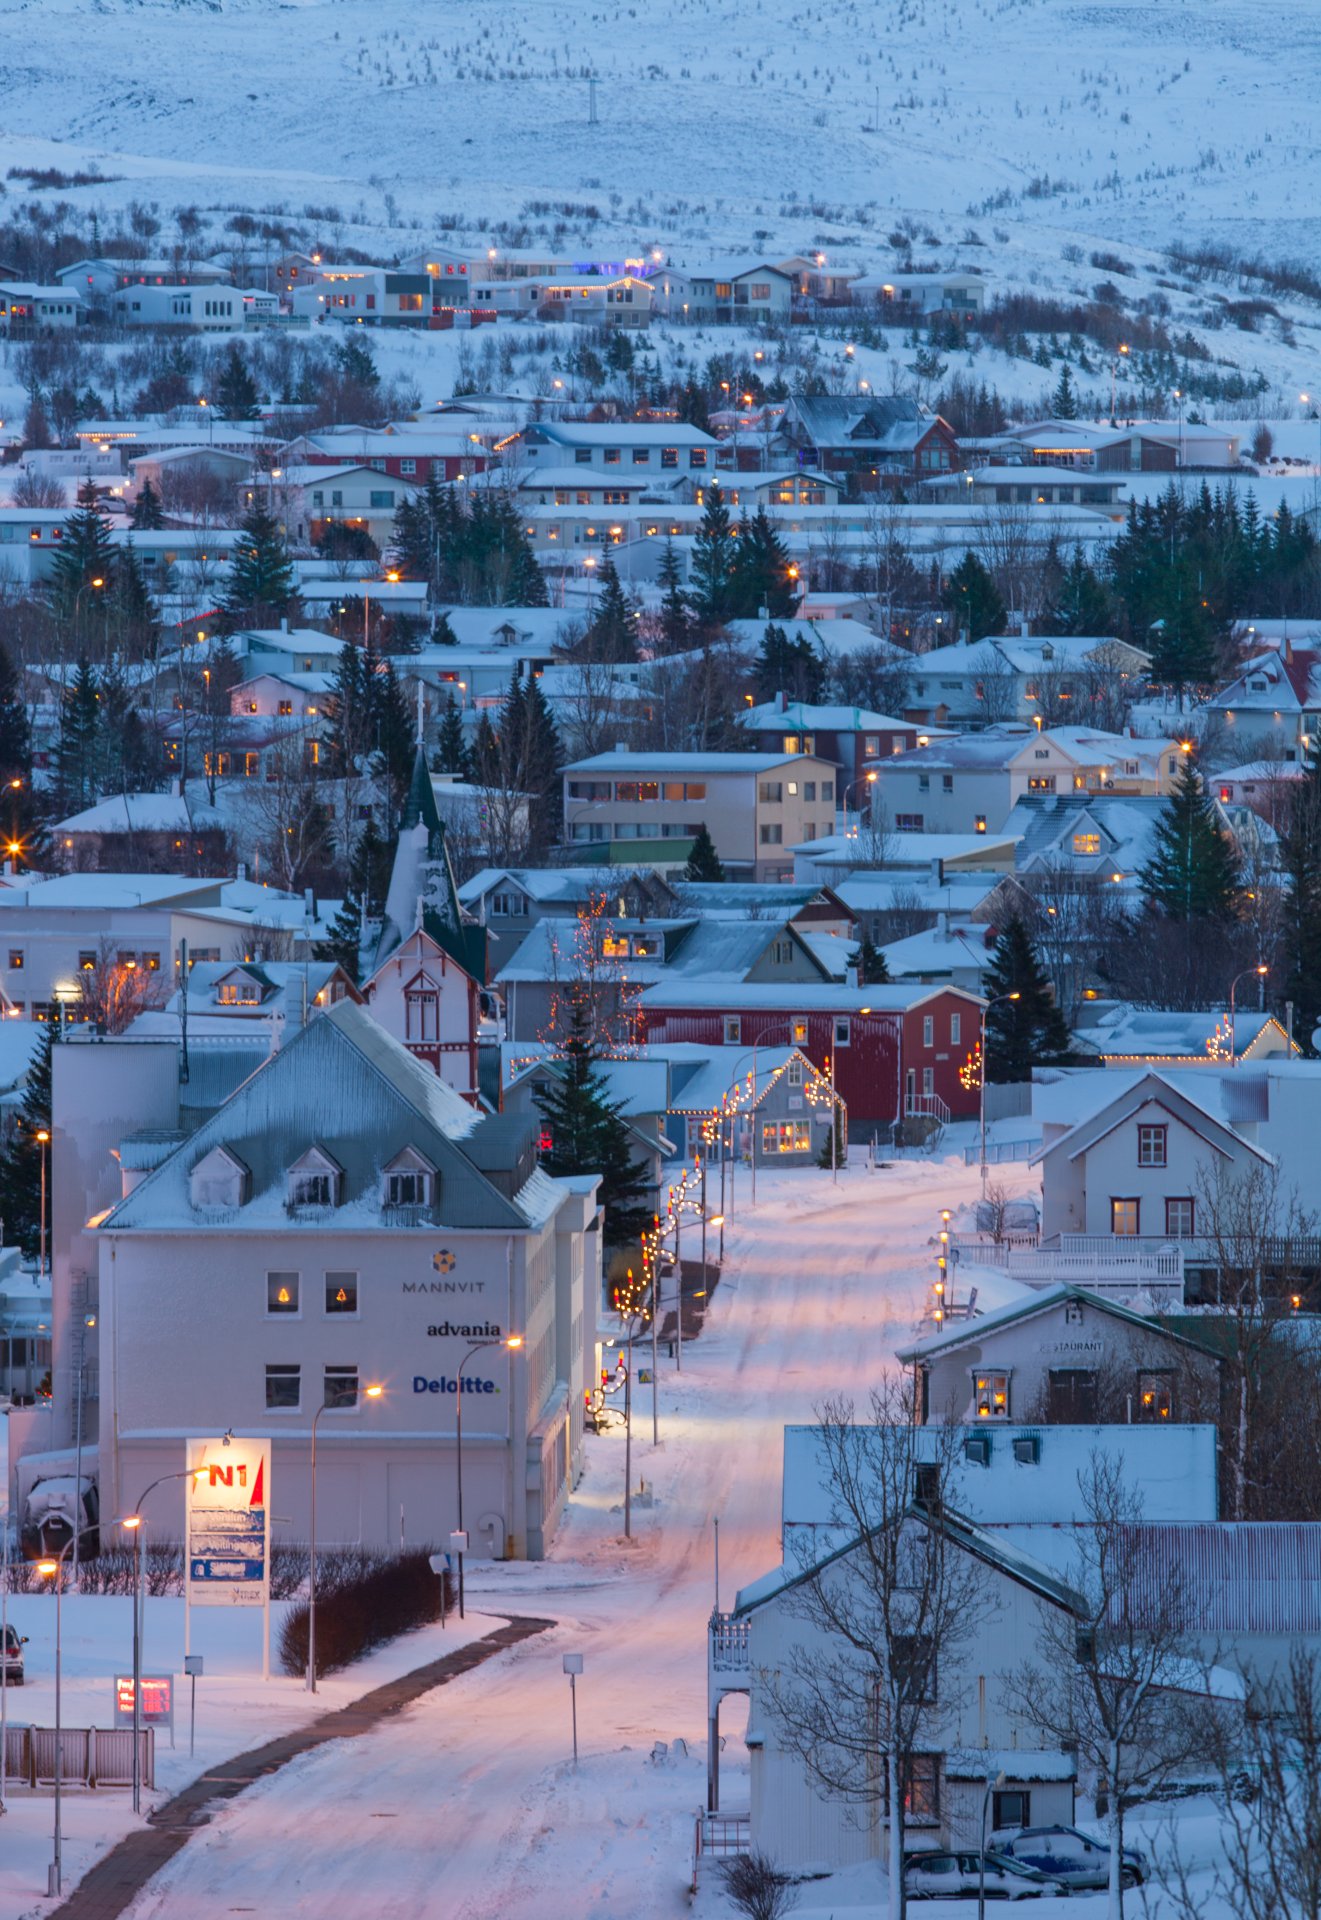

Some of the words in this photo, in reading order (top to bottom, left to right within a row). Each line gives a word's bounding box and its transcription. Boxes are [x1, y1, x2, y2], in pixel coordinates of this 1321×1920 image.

[402, 1282, 485, 1293] MANNVIT
[427, 1321, 501, 1337] advania
[209, 1464, 247, 1488] N1
